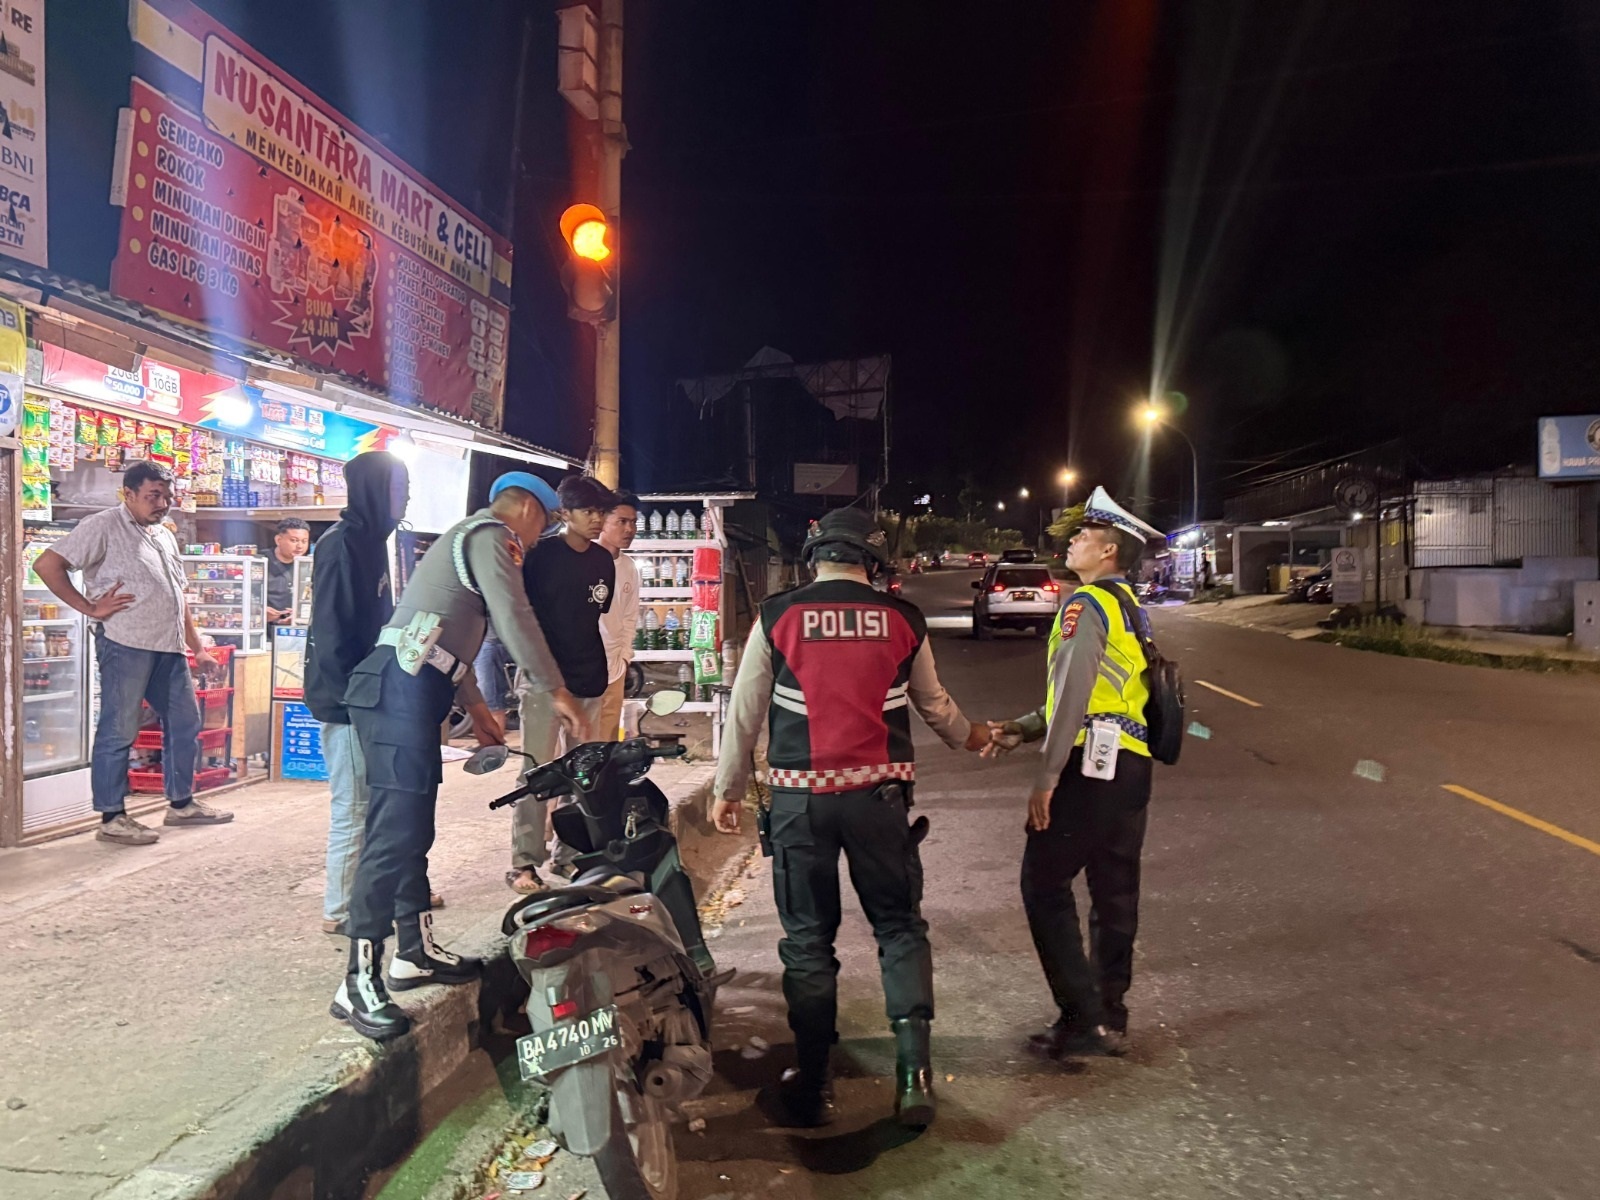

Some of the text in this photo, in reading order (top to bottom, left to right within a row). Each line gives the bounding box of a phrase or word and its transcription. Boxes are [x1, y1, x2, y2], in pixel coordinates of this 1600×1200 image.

[158, 114, 224, 169] SEMBAKO
[1, 145, 35, 176] BNI
[156, 146, 205, 190] ROKOK
[215, 50, 488, 270] NUSANTARA MART & CELL
[0, 184, 31, 212] BCA
[154, 178, 267, 250] MINUMAN DINGIN
[246, 128, 471, 284] MENYEDIAKAN ANEKA KEBUTUHAN ANDA
[152, 211, 263, 277] MINUMAN PANAS
[149, 243, 239, 297] GAS LPG 3 KG
[398, 253, 421, 278] PULSA
[422, 267, 434, 285] ALL
[397, 269, 437, 304] PAKET DATA
[306, 298, 333, 318] BUKA
[395, 287, 446, 325] TOKEN LISTRIK
[302, 318, 339, 338] 24 JAM
[421, 333, 451, 359] E-MONEY
[113, 380, 141, 397] 50.000
[153, 377, 178, 394] 10GB
[803, 610, 889, 638] POLISI
[523, 1036, 546, 1060] BA
[546, 1020, 590, 1051] 4740
[602, 1034, 619, 1048] 26
